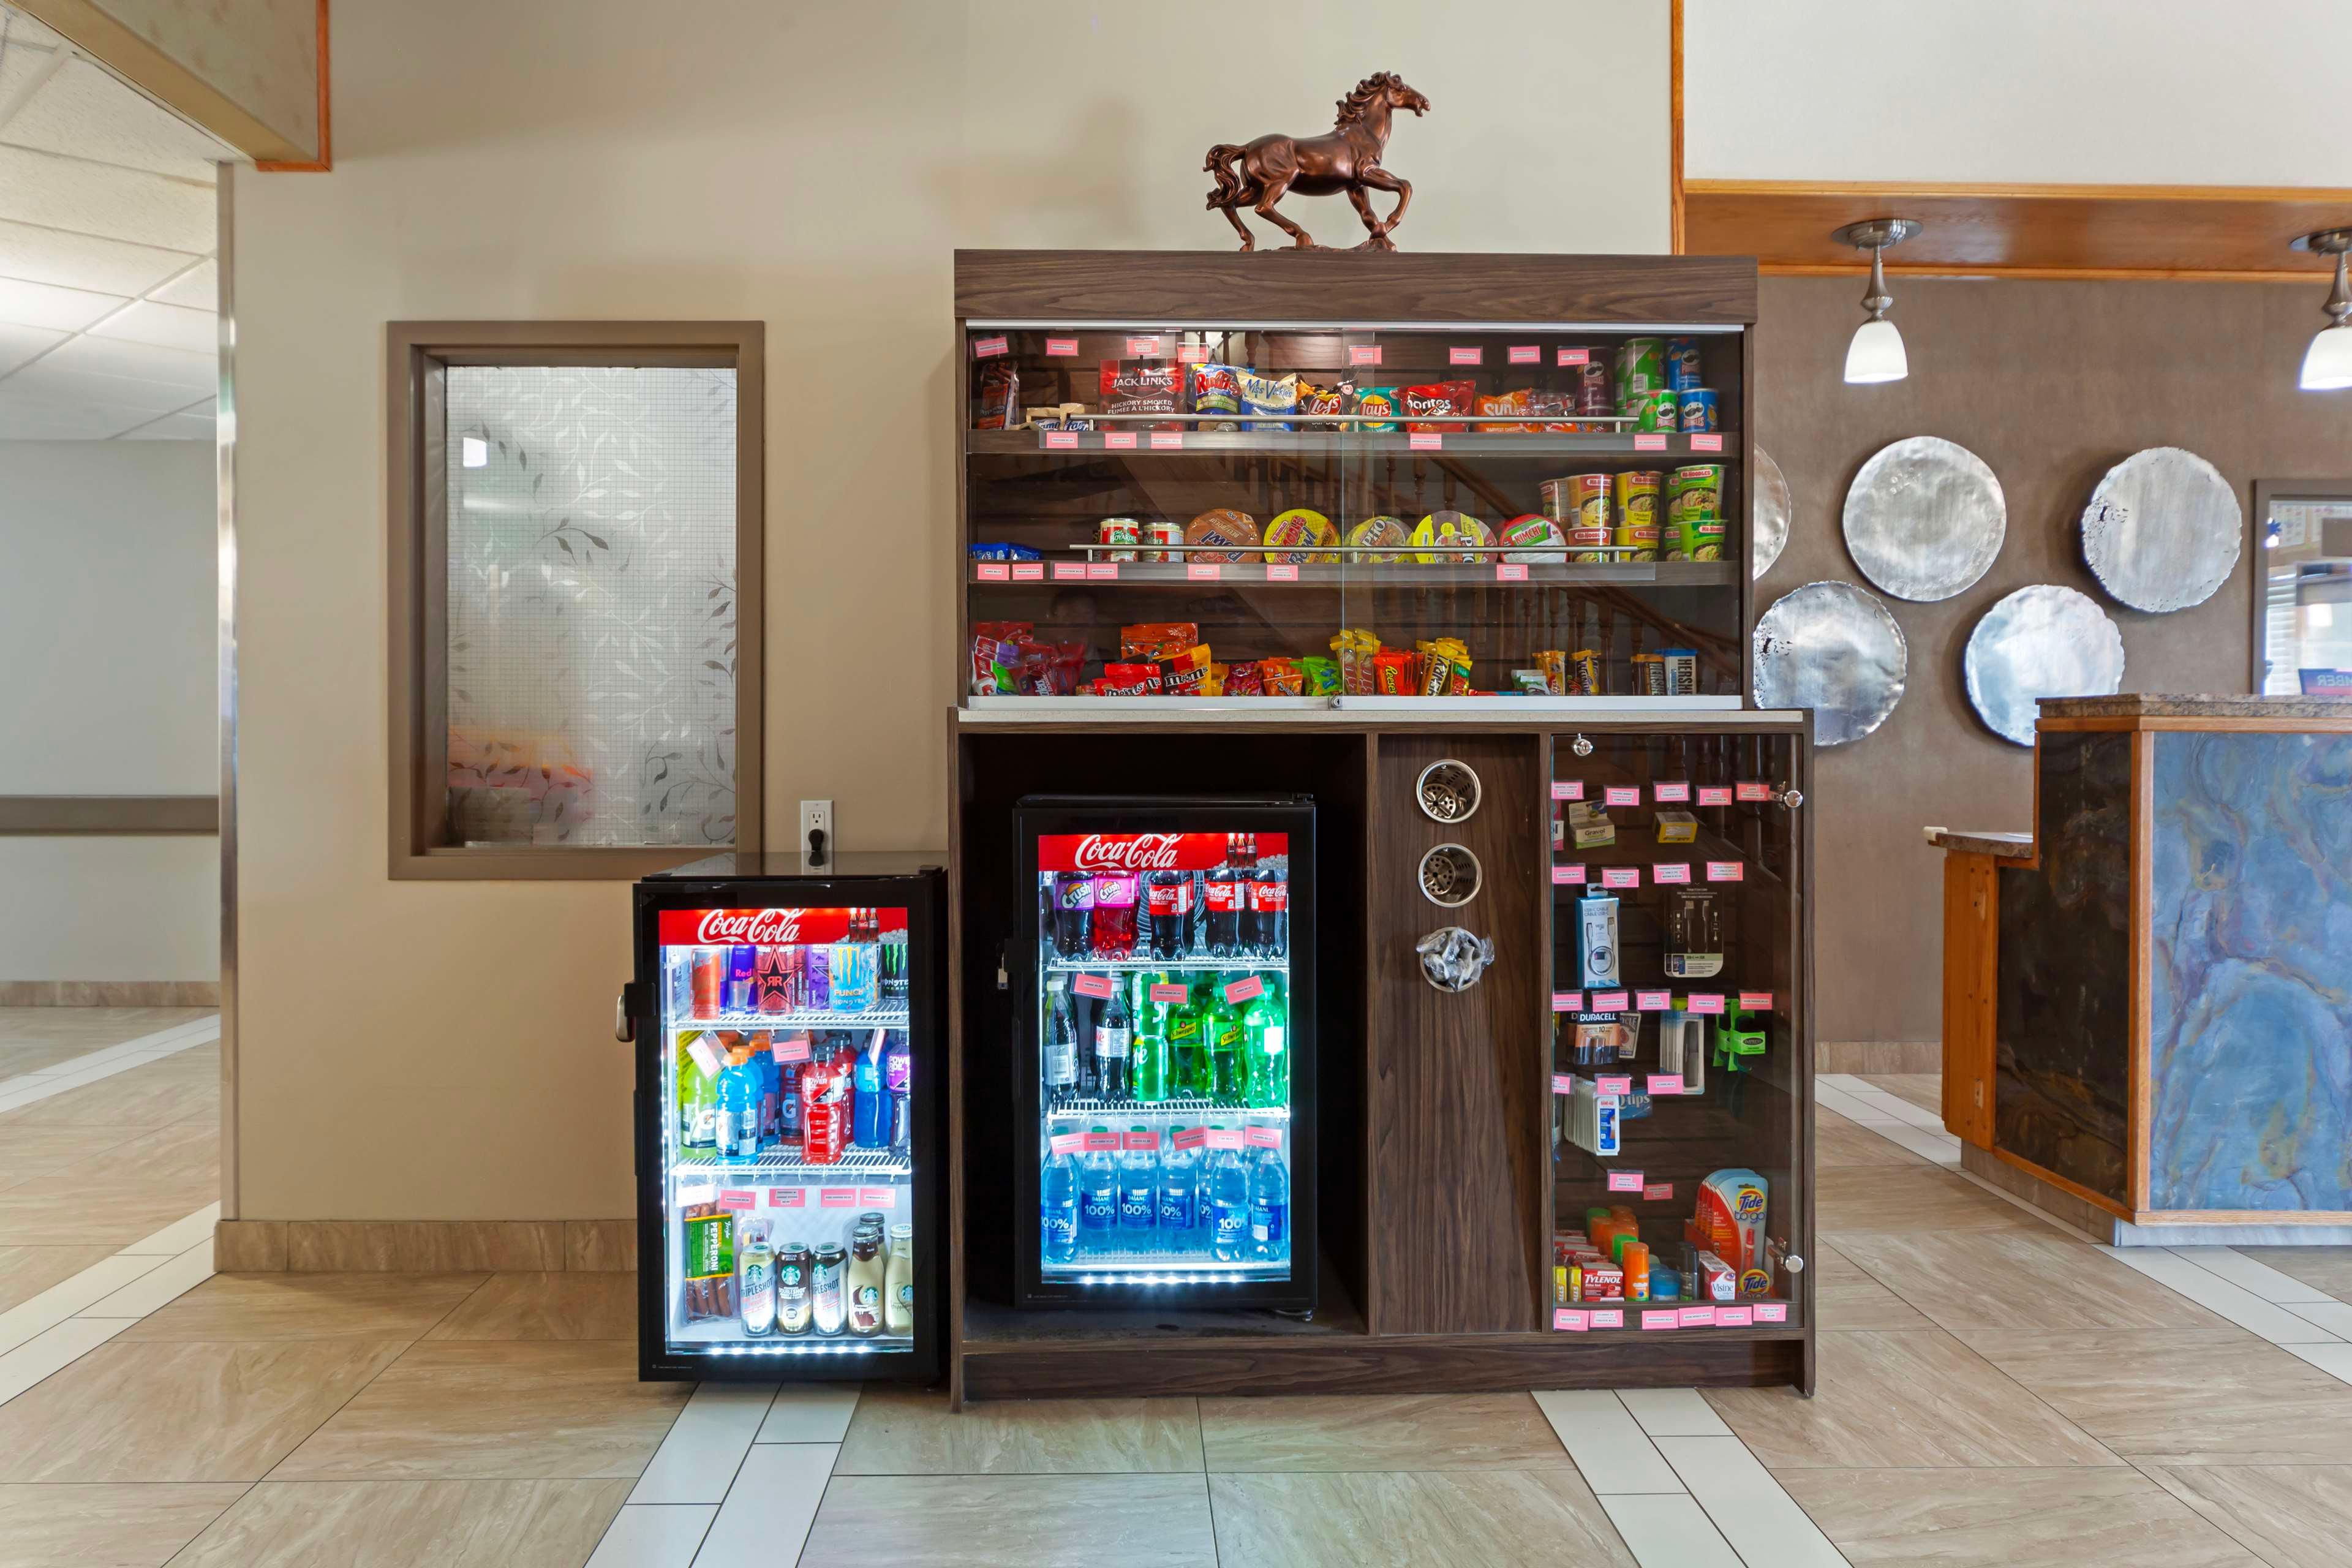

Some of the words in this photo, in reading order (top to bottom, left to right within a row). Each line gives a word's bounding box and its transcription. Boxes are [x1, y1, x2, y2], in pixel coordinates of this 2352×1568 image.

[1112, 377, 1139, 388] JACK
[1140, 377, 1173, 386] LINK'S
[1246, 379, 1265, 399] Miss
[1266, 381, 1292, 400] Vickie's
[1111, 400, 1140, 409] HICKORY
[1361, 519, 1386, 546] PHO
[1514, 525, 1542, 546] KIMCHI
[1385, 665, 1398, 695] Reese's
[1678, 658, 1693, 696] HERSHE
[1075, 833, 1184, 869] Coca-Cola
[1061, 882, 1091, 908] Crush
[1099, 881, 1120, 900] Crush
[698, 908, 806, 943] Coca-Cola
[736, 968, 752, 978] Red
[1580, 1012, 1616, 1022] DURACELL
[1085, 1205, 1115, 1216] 100%
[1122, 1202, 1152, 1215] 100%
[1739, 1194, 1764, 1212] Tide
[1735, 1210, 1748, 1221] to
[1750, 1211, 1765, 1224] go
[710, 1222, 718, 1271] PEPPERONI
[740, 1276, 773, 1297] TRIPLESHOT
[1585, 1274, 1621, 1284] TYLENOL
[1712, 1283, 1733, 1292] Visine
[1744, 1276, 1768, 1293] Tide
